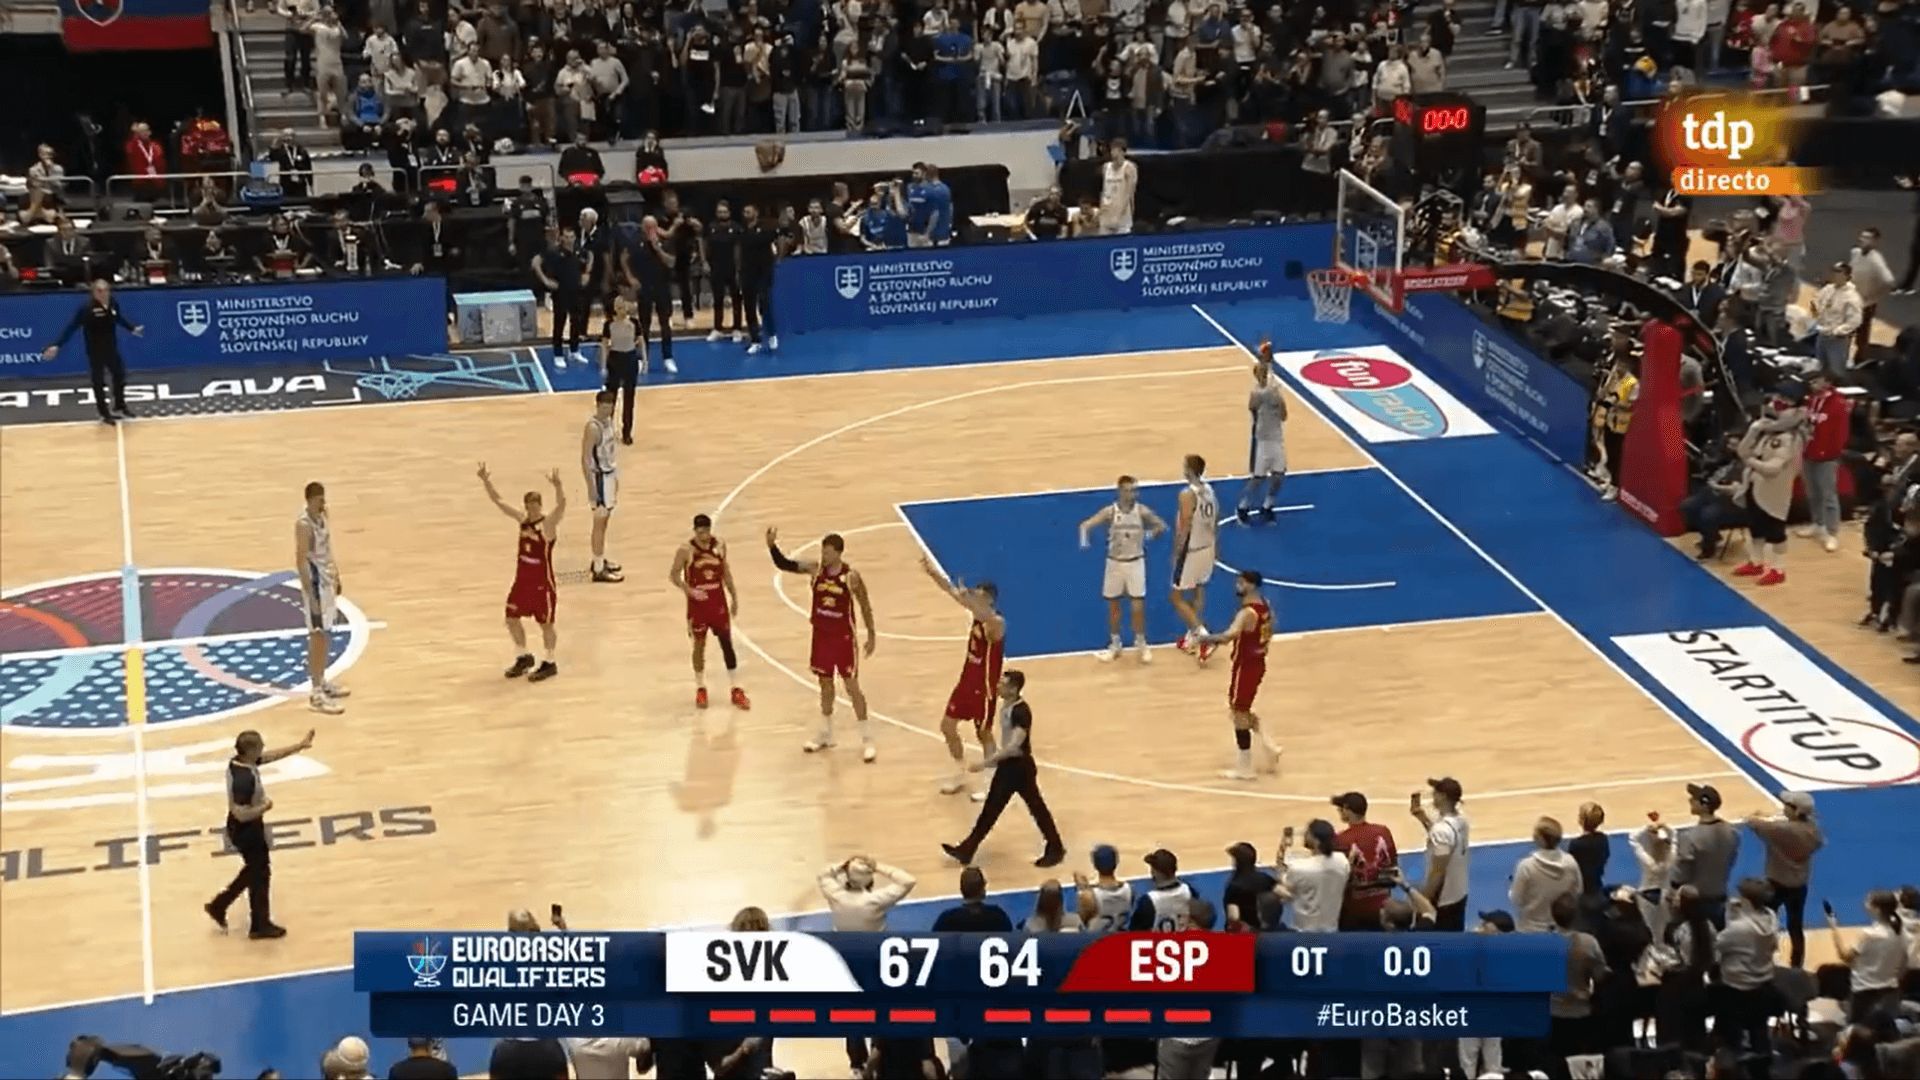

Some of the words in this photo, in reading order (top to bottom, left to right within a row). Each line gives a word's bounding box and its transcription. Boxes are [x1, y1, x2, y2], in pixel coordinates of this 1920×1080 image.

[1143, 242, 1225, 256] MINISTERSTVO
[869, 260, 953, 275] MINISTERSTVO
[1220, 257, 1263, 269] RUCHU
[949, 275, 993, 287] RUCHU
[217, 295, 313, 310] MINISTERSTVO
[218, 313, 307, 329] CESTOVNÉHO
[311, 312, 359, 324] RUCHU
[219, 330, 229, 341] A
[220, 339, 298, 354] SLOVENSKEJ
[302, 335, 369, 349] REPUBLIKY
[1330, 360, 1381, 387] fun
